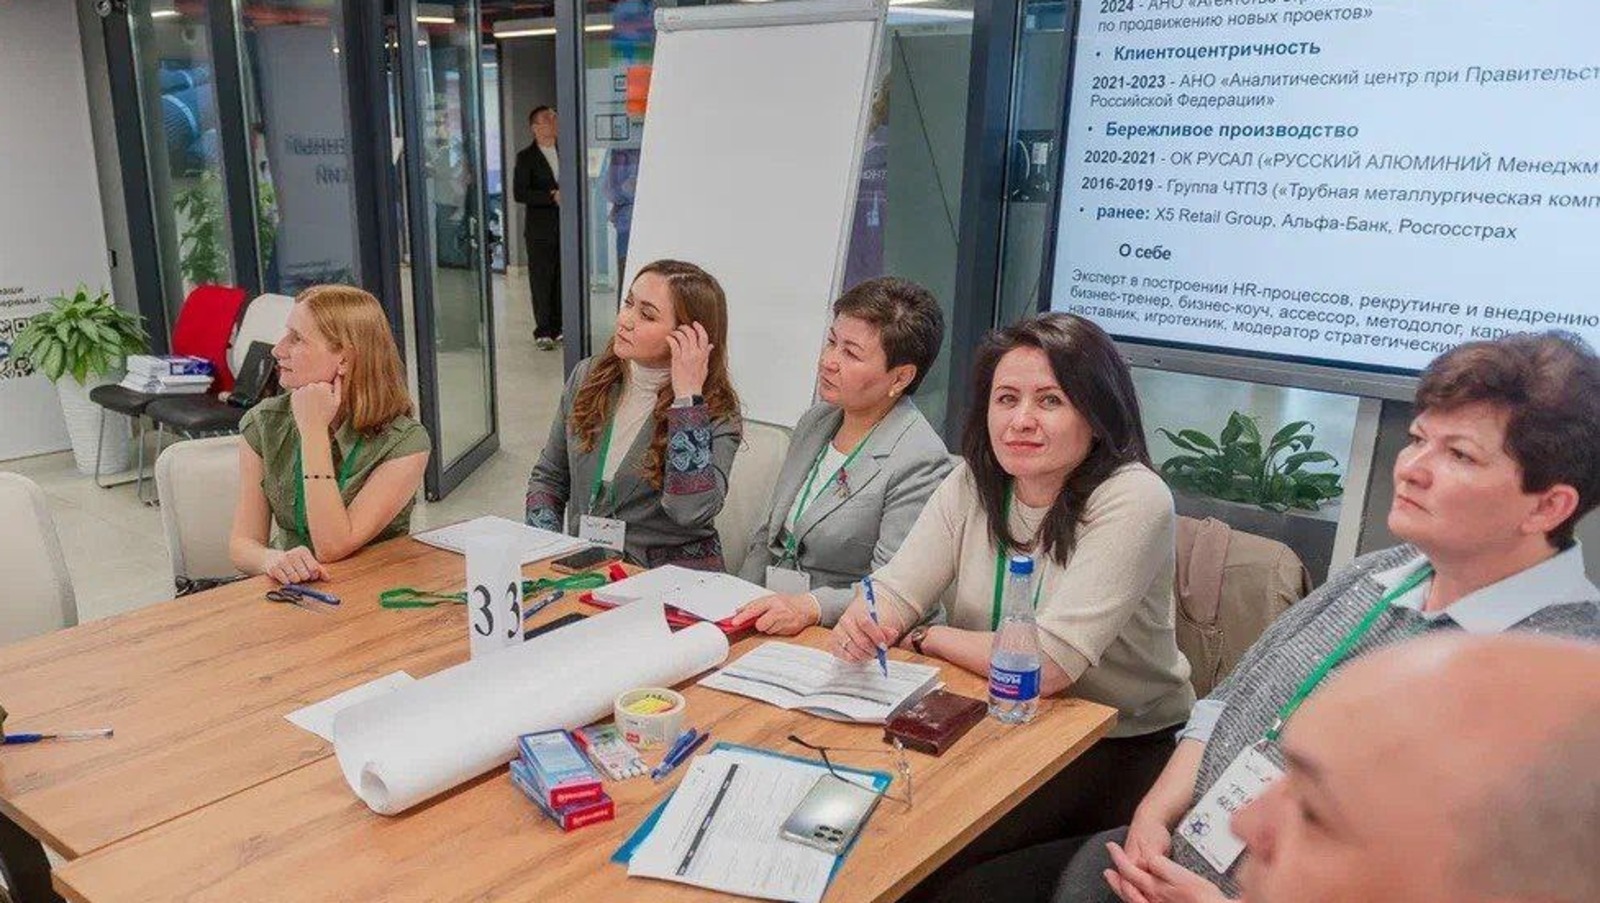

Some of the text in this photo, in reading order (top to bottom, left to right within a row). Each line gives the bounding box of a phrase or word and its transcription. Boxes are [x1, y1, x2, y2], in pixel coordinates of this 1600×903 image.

[1098, 7, 1374, 33] по продвижению новых проектов»
[1100, 0, 1134, 14] 2024
[1113, 40, 1321, 61] Клиентоцентричность
[1092, 74, 1166, 90] 2021-2023
[1178, 73, 1216, 88] АНО
[1221, 69, 1359, 88] «Аналитический
[1364, 69, 1418, 87] центр
[1423, 69, 1459, 86] при
[1090, 92, 1275, 110] Российской Федерации»
[1105, 121, 1359, 140] Бережливое производство
[1083, 150, 1156, 165] 2020-2021
[1170, 151, 1193, 166] ОК
[1196, 151, 1253, 167] РУСАЛ
[1257, 150, 1361, 170] («РУССКИЙ
[1365, 153, 1492, 172] АЛЮМИНИЙ
[1497, 156, 1599, 176] Менеджм
[1081, 176, 1154, 192] 2016-2019
[1167, 179, 1218, 197] Группа
[1222, 180, 1268, 196] ЧТПЗ
[1271, 181, 1359, 201] («Трубная
[1364, 187, 1542, 207] металлургическая
[1095, 206, 1150, 220] ранее:
[1178, 208, 1221, 223] Retail
[1281, 213, 1393, 235] Альфа-Банк,
[1398, 218, 1518, 241] Росгосстрах
[1118, 243, 1172, 260] О себе
[1069, 284, 1172, 308] бизнес-тренер,
[1178, 295, 1274, 319] бизнес-коуч,
[1279, 309, 1360, 327] ассессор,
[1366, 315, 1464, 338] методолог,
[1071, 268, 1599, 328] Эксперт в построении HR-процессов, рекрутинге и внедрению
[1068, 305, 1140, 322] наставник,
[1144, 311, 1227, 332] игротехник,
[1232, 320, 1320, 342] модератор
[473, 584, 494, 637] 3
[505, 581, 521, 639] 3
